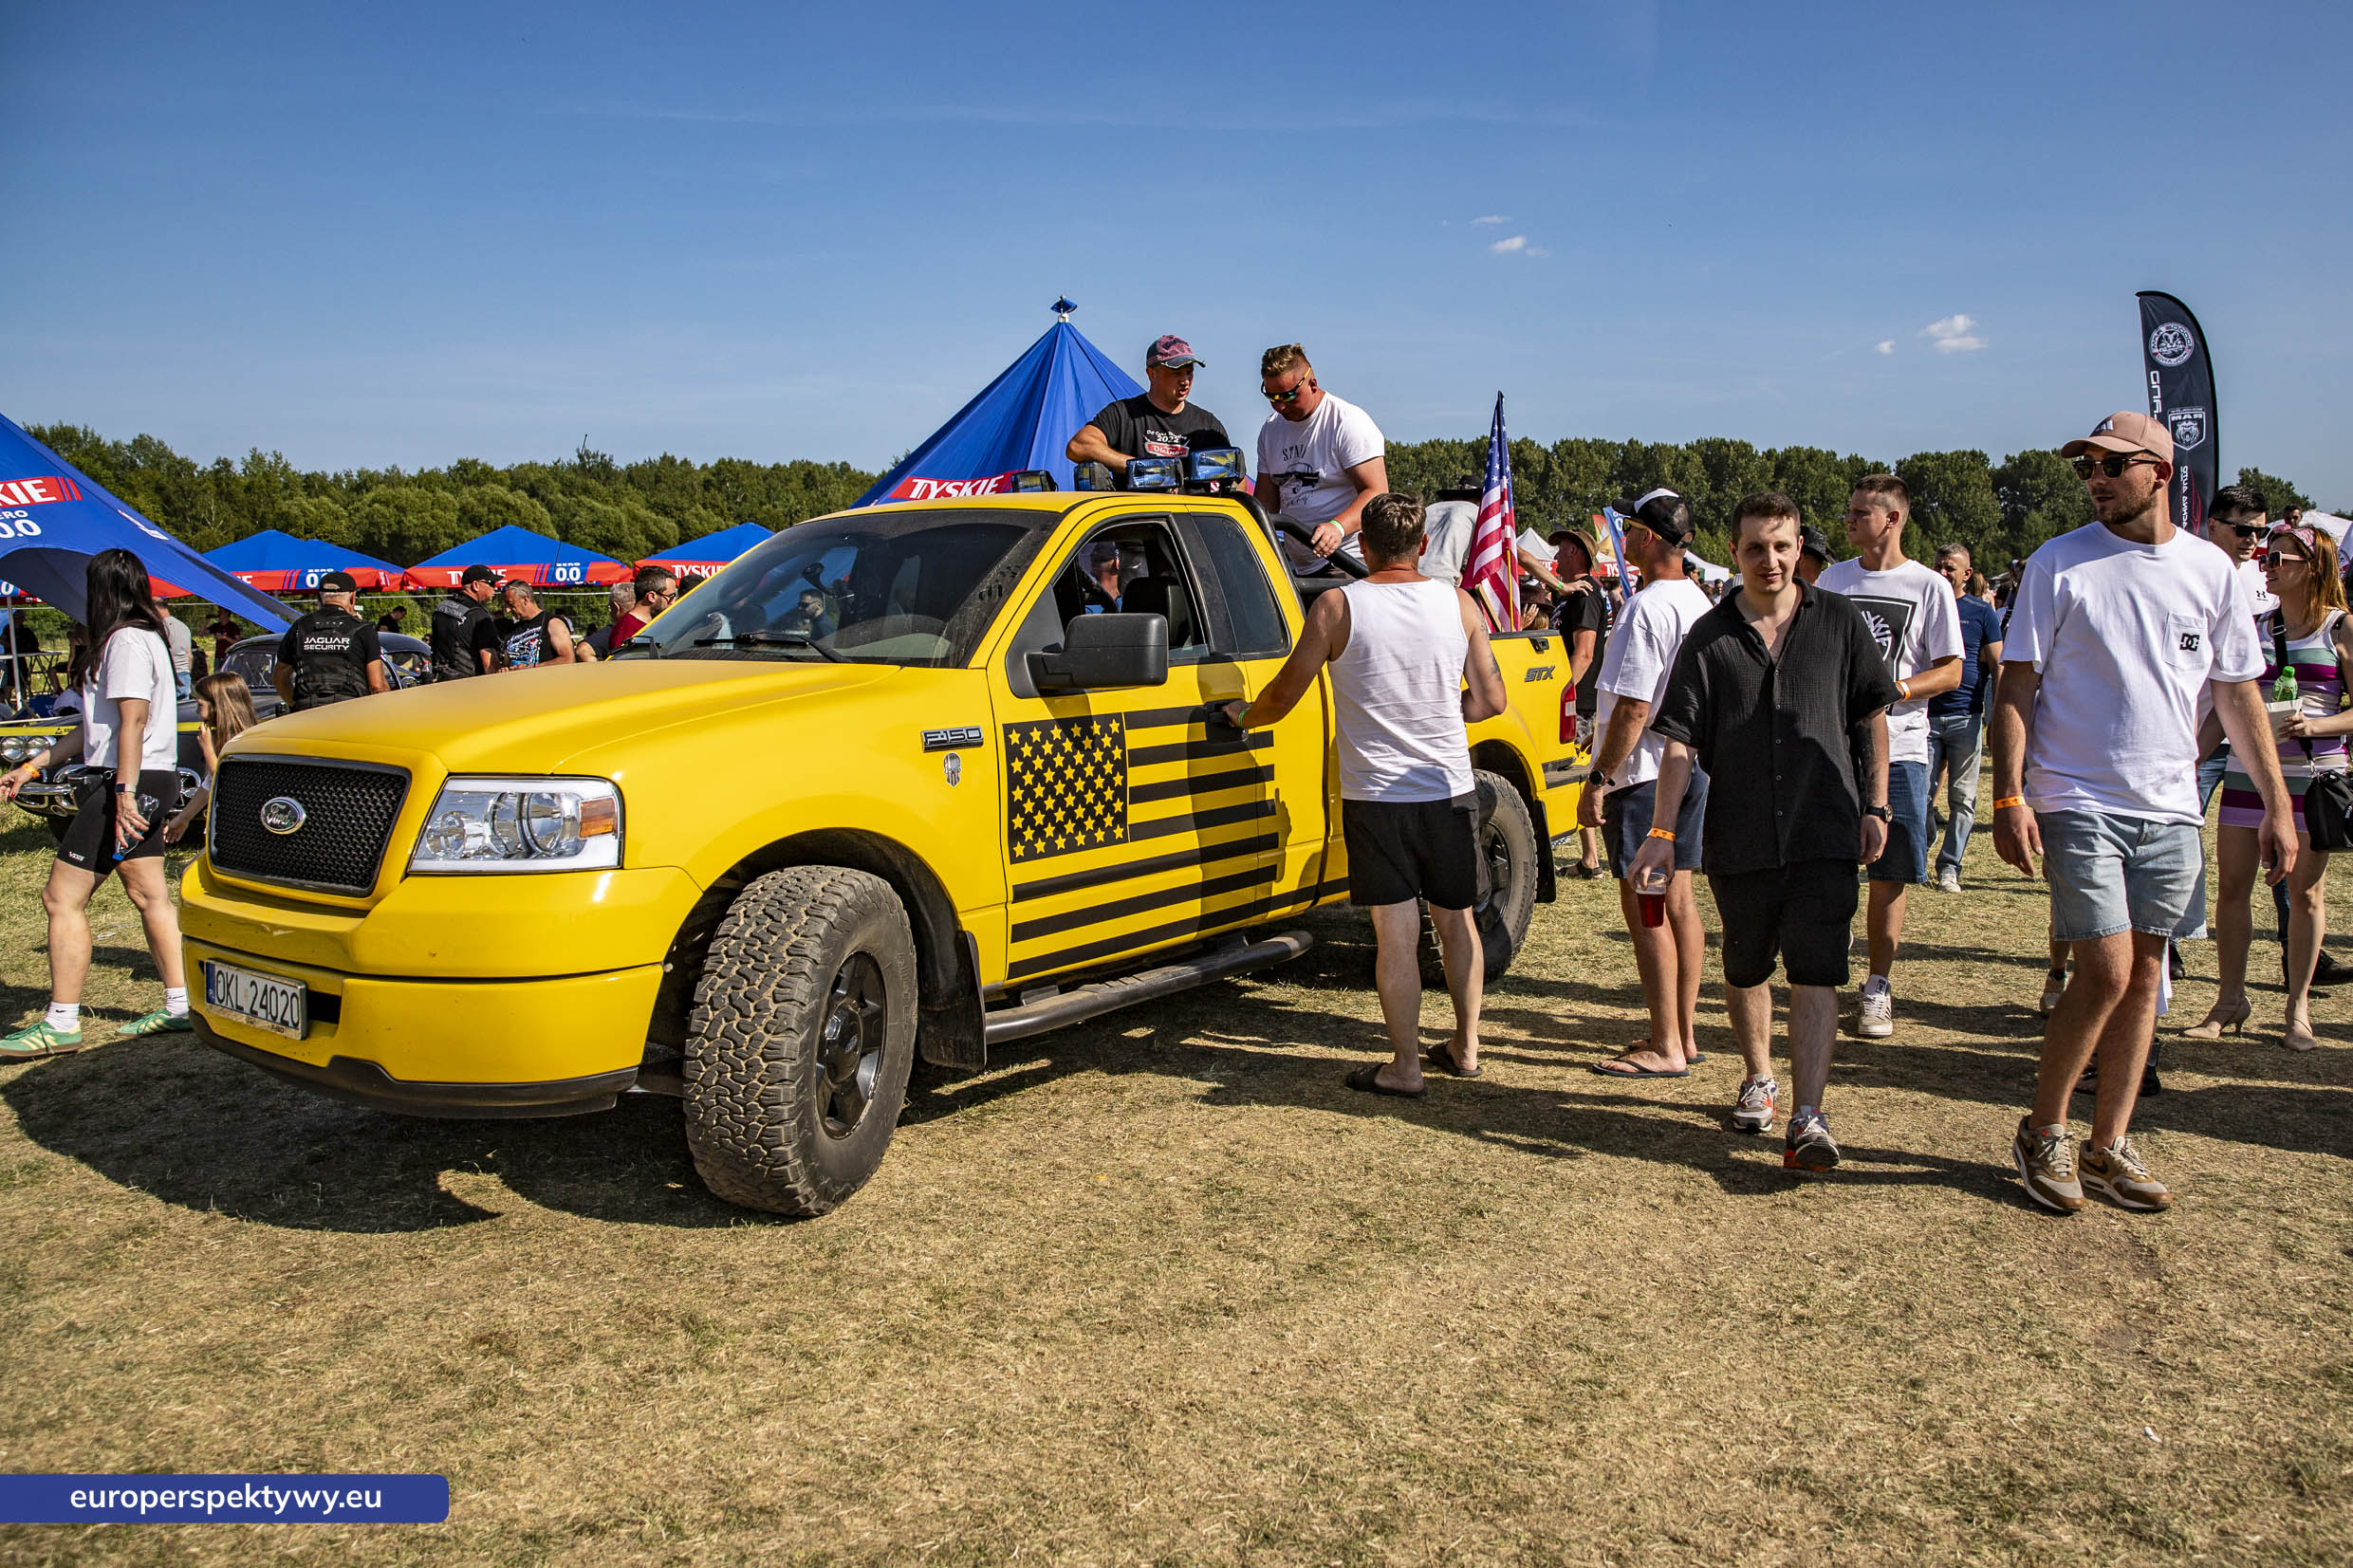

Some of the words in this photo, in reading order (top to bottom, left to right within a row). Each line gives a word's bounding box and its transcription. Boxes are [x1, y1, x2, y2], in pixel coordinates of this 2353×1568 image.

[1157, 435, 1179, 444] 2022
[908, 474, 1005, 500] TYSKIE
[555, 566, 582, 581] 0.0
[1524, 664, 1556, 683] STX
[215, 969, 245, 1012] OKL
[250, 980, 300, 1028] 24020
